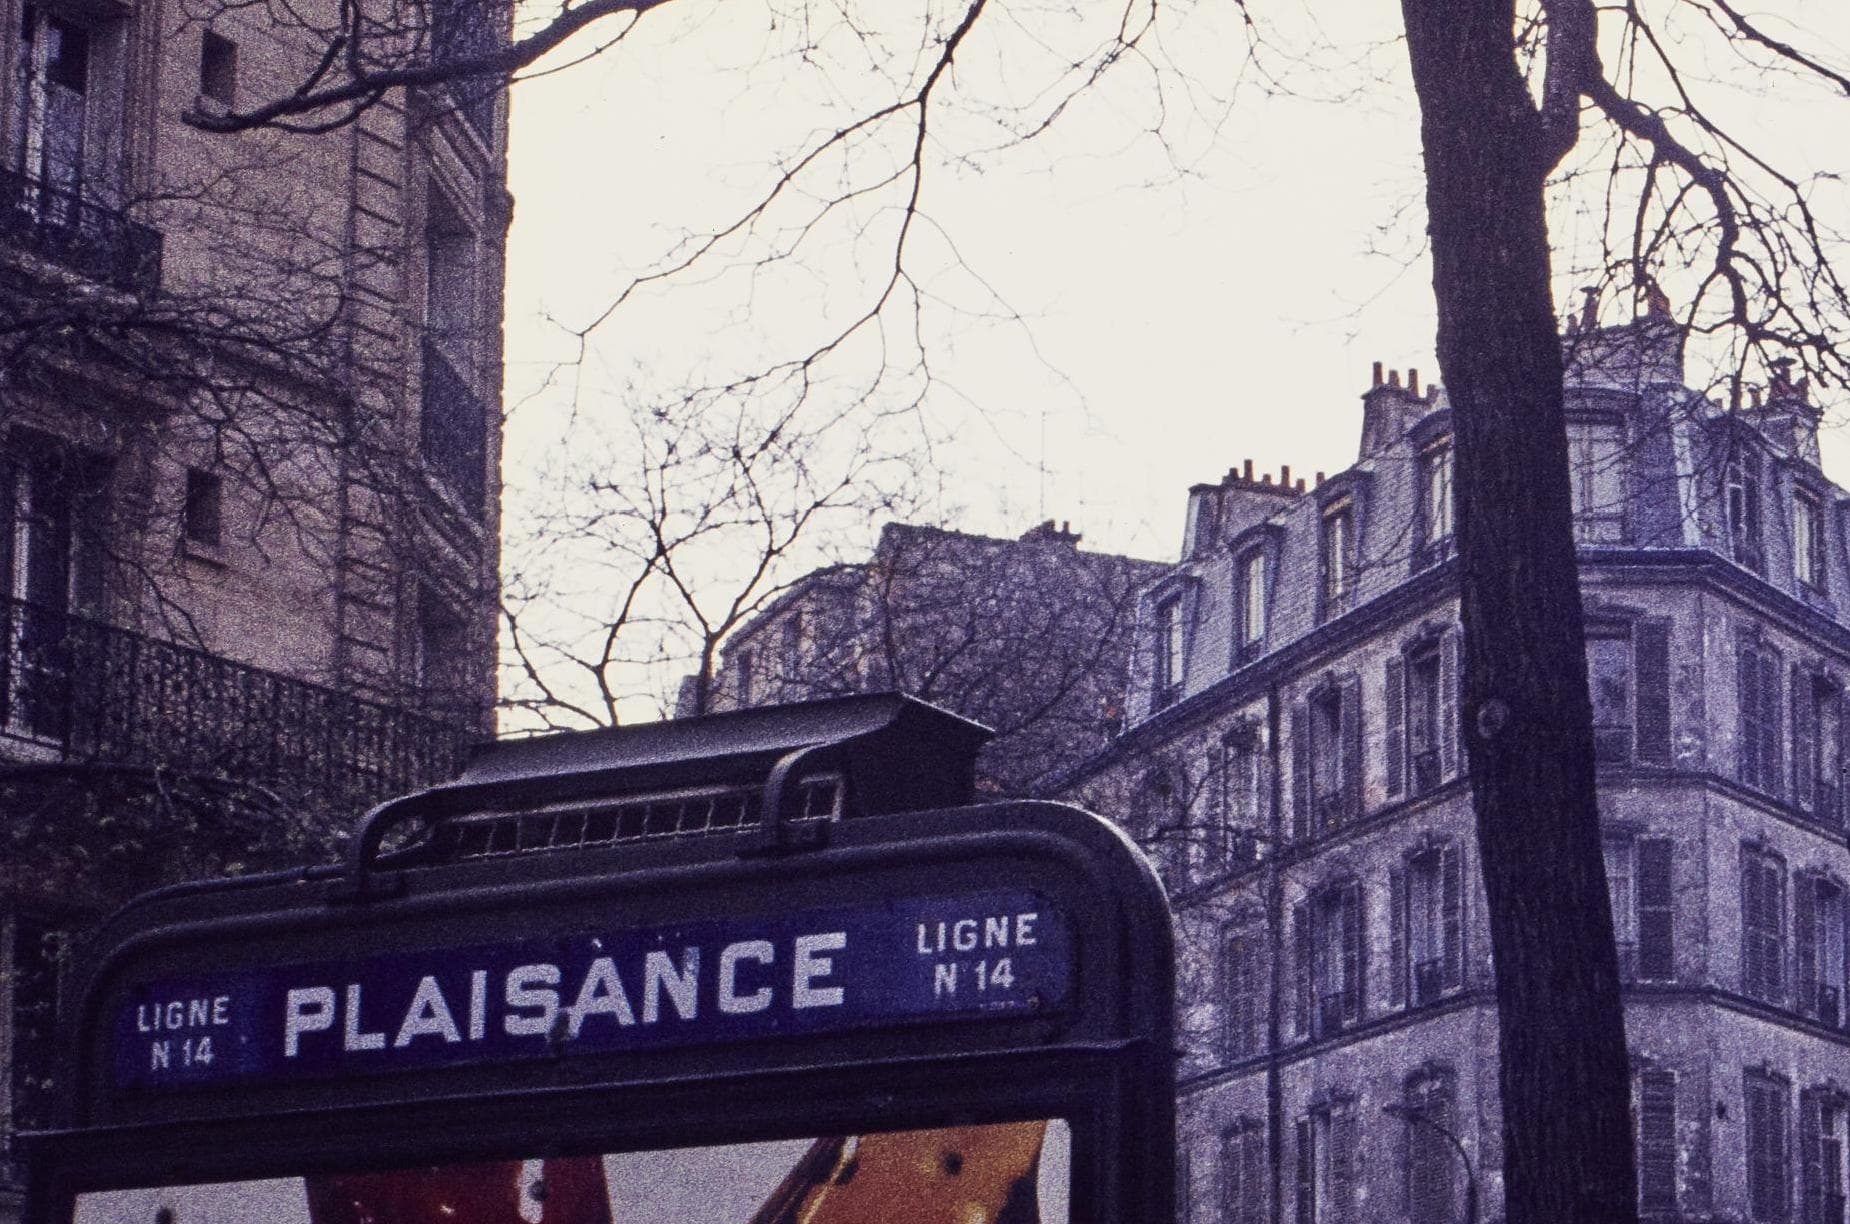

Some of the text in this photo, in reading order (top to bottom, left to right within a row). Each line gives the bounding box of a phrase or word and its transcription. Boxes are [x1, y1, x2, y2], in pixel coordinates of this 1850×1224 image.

[915, 911, 1038, 956] LIGNE
[281, 931, 848, 1058] PLAISANCE
[974, 957, 1015, 992] 14
[136, 992, 231, 1034] LIGNE
[186, 1036, 213, 1068] 14
